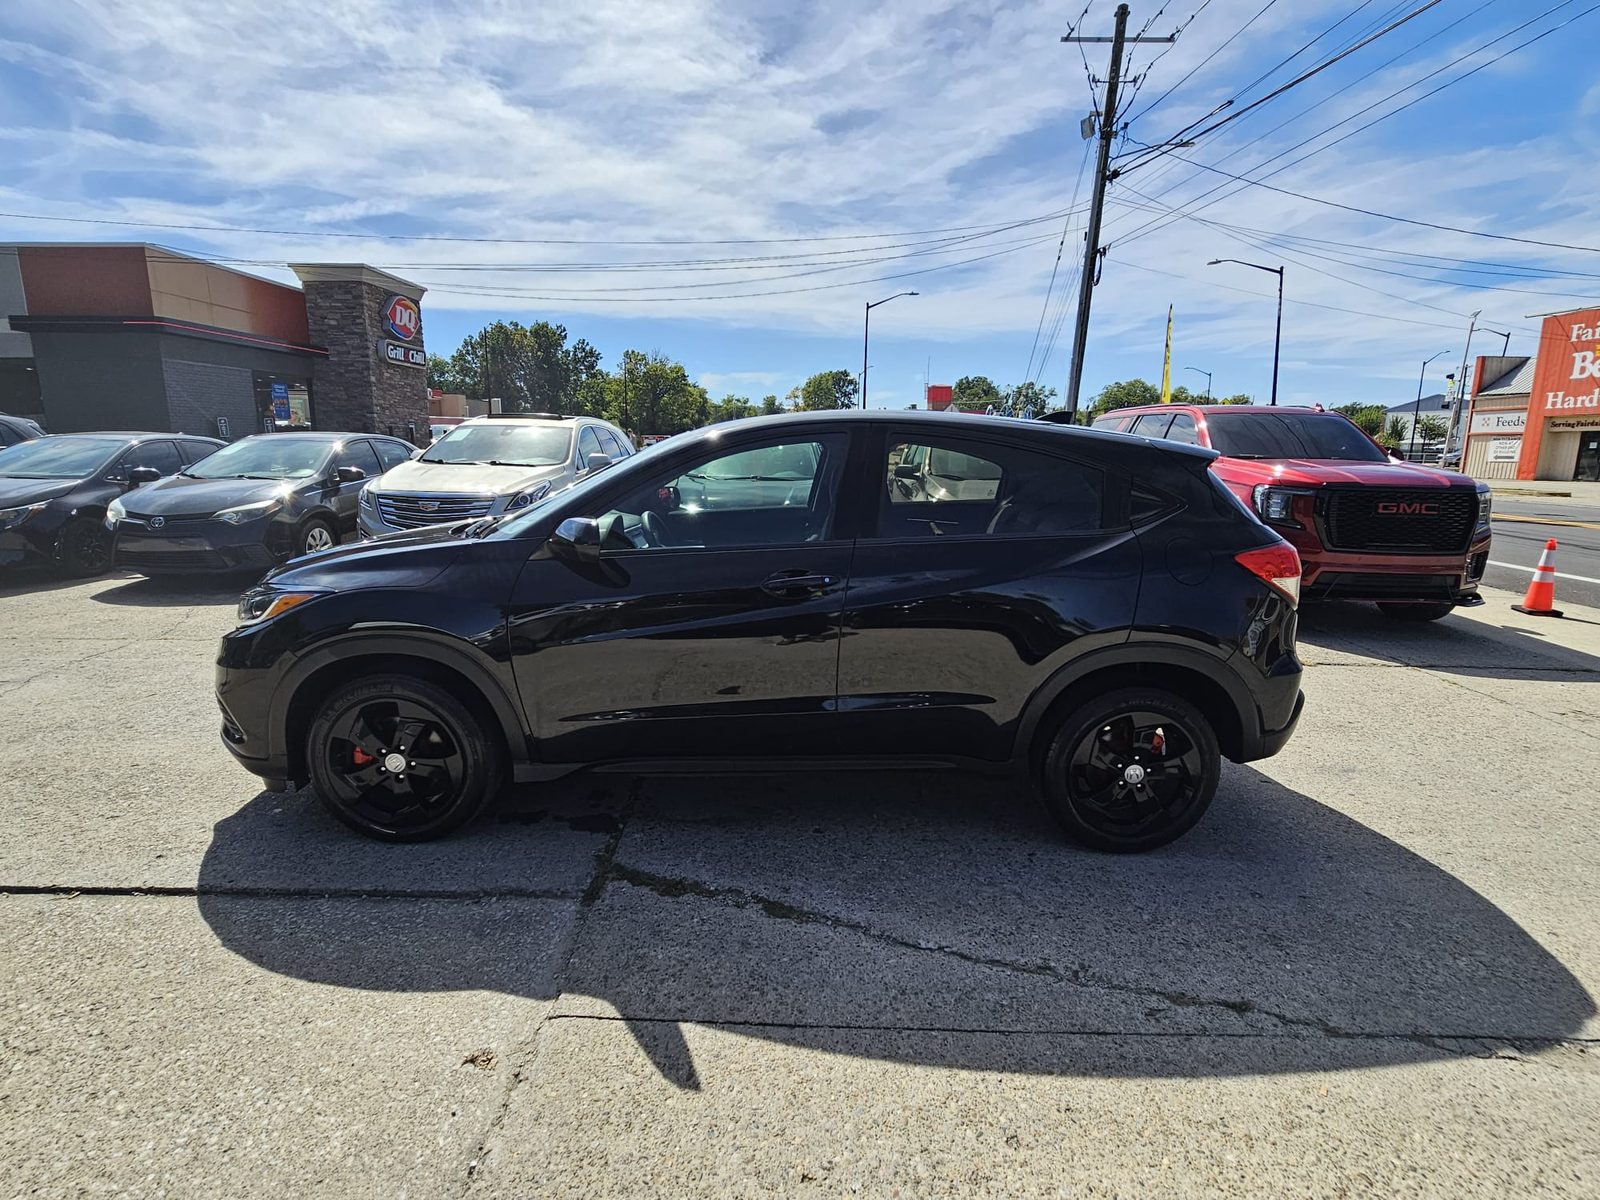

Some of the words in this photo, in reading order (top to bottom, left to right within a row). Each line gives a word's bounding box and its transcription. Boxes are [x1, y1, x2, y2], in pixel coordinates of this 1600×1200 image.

[395, 305, 415, 331] DQ
[388, 346, 404, 361] Grill
[409, 350, 425, 364] Chill
[1545, 388, 1600, 409] Hard
[1496, 416, 1525, 427] Feeds
[1550, 420, 1575, 429] Serving
[1378, 502, 1440, 515] GMC
